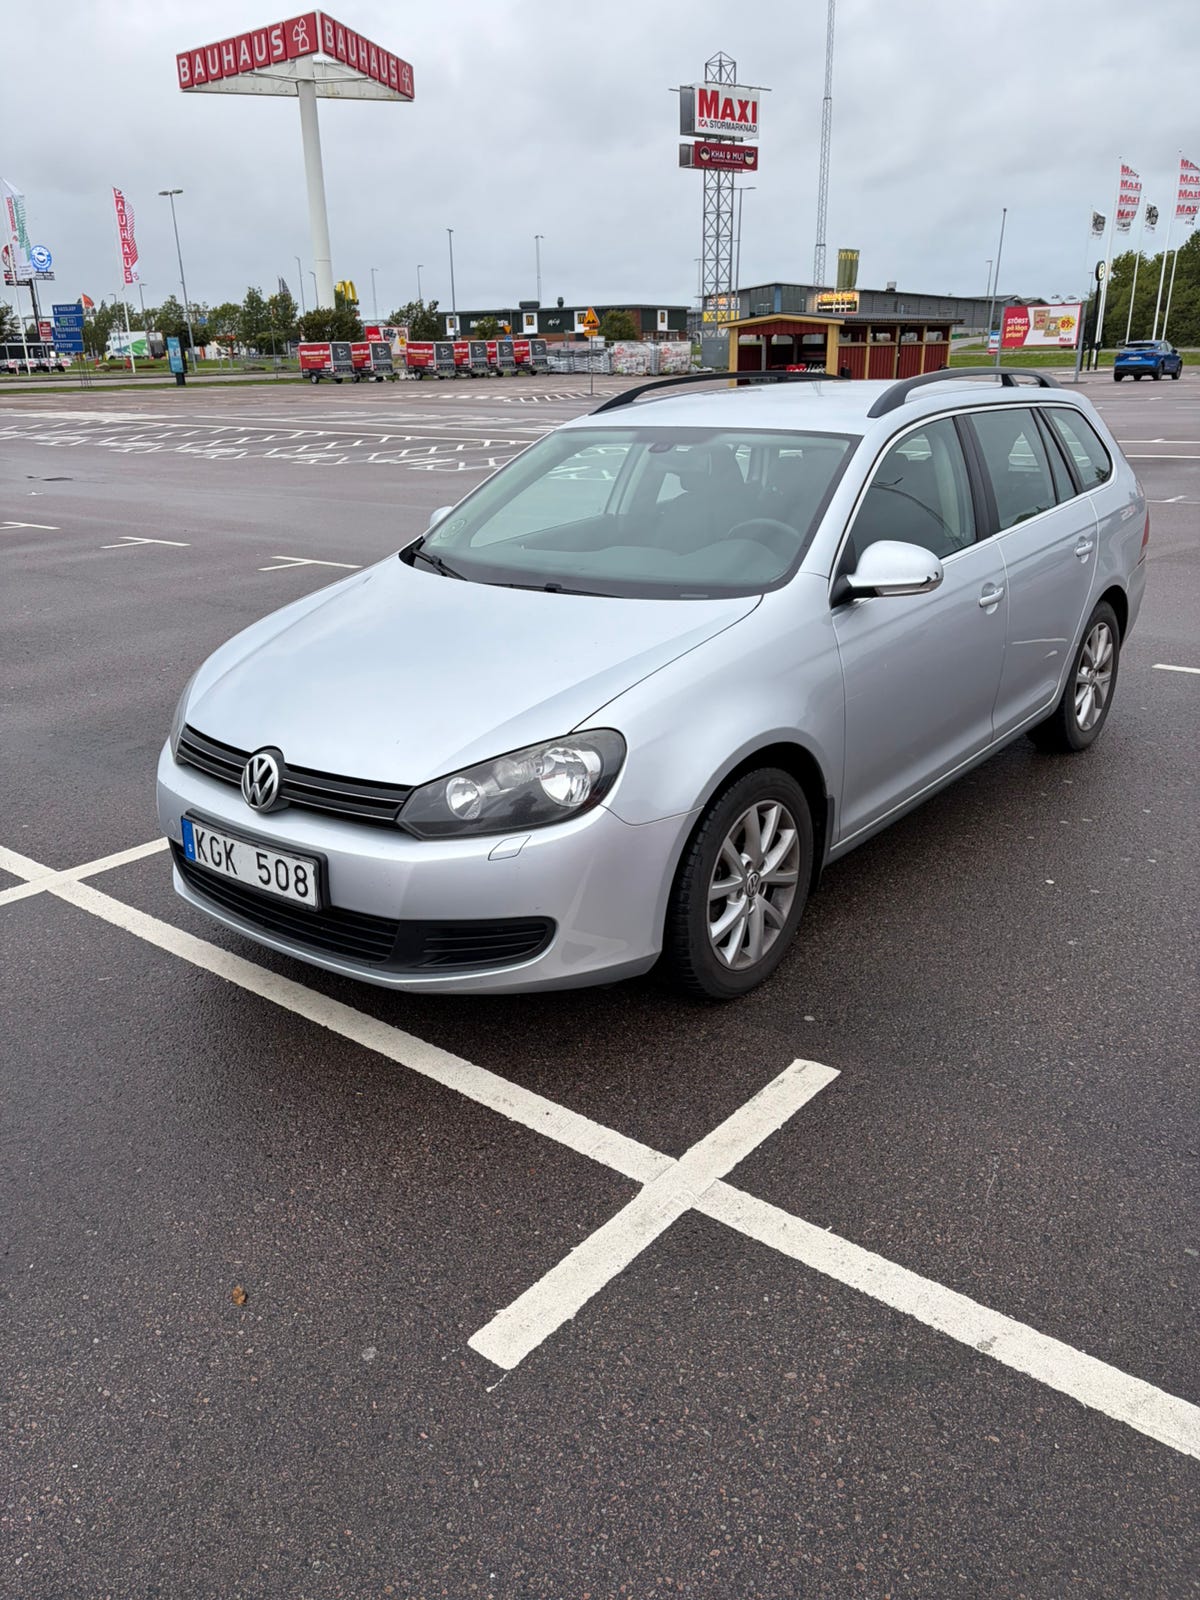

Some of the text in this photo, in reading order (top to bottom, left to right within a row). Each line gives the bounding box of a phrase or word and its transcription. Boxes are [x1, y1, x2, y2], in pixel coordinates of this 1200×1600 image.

[179, 28, 284, 82] BAUHAUS
[324, 19, 398, 83] BAUHAUS
[698, 89, 758, 124] MAXI
[709, 120, 758, 133] STORMARKNAD
[1119, 195, 1140, 204] MAXI
[1120, 180, 1142, 190] MAXI
[195, 828, 310, 898] KGK 508
